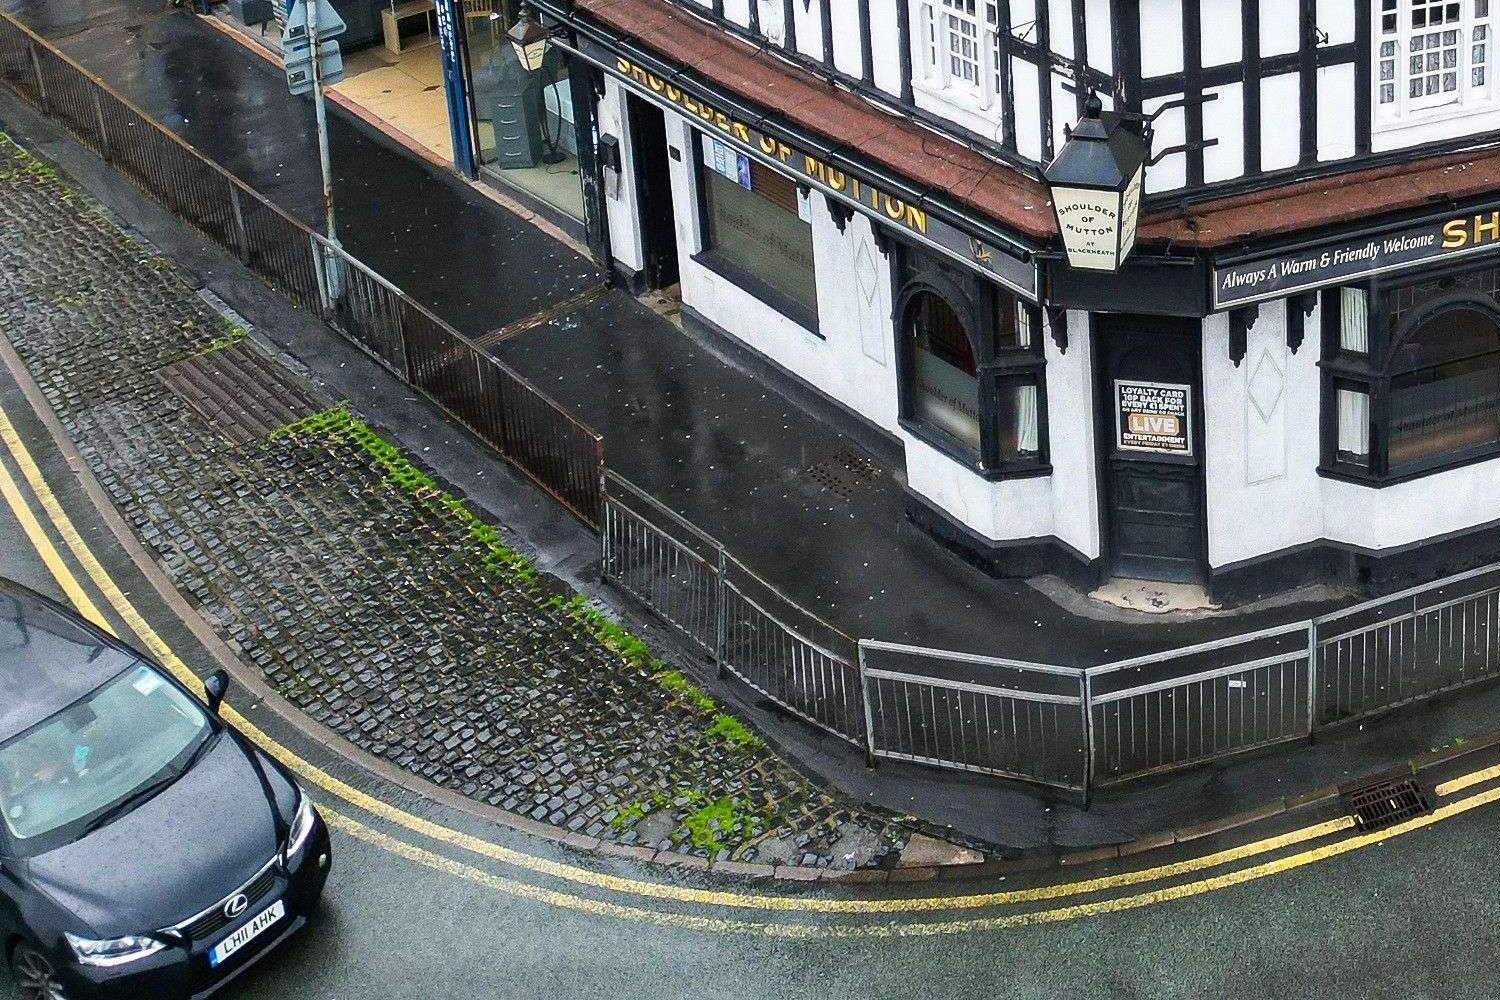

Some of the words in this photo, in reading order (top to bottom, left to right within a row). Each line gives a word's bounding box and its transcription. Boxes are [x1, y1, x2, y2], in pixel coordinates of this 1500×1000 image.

[1058, 203, 1116, 219] SHOULDER
[1065, 223, 1114, 236] MUTTON
[1222, 268, 1266, 290] Always
[1268, 264, 1278, 280] A
[1280, 258, 1317, 277] Warm
[1320, 253, 1330, 268] &
[1333, 242, 1380, 265] Friendly
[1383, 234, 1435, 254] Welcome
[1122, 387, 1158, 396] LOYALTY
[1160, 389, 1184, 398] CARD
[1122, 400, 1148, 408] EVERY
[1140, 395, 1163, 404] BACK
[1165, 397, 1183, 405] FOR
[1132, 416, 1176, 433] LIVE
[1123, 432, 1186, 444] ENTERTAINMENT
[252, 906, 277, 934] AHK
